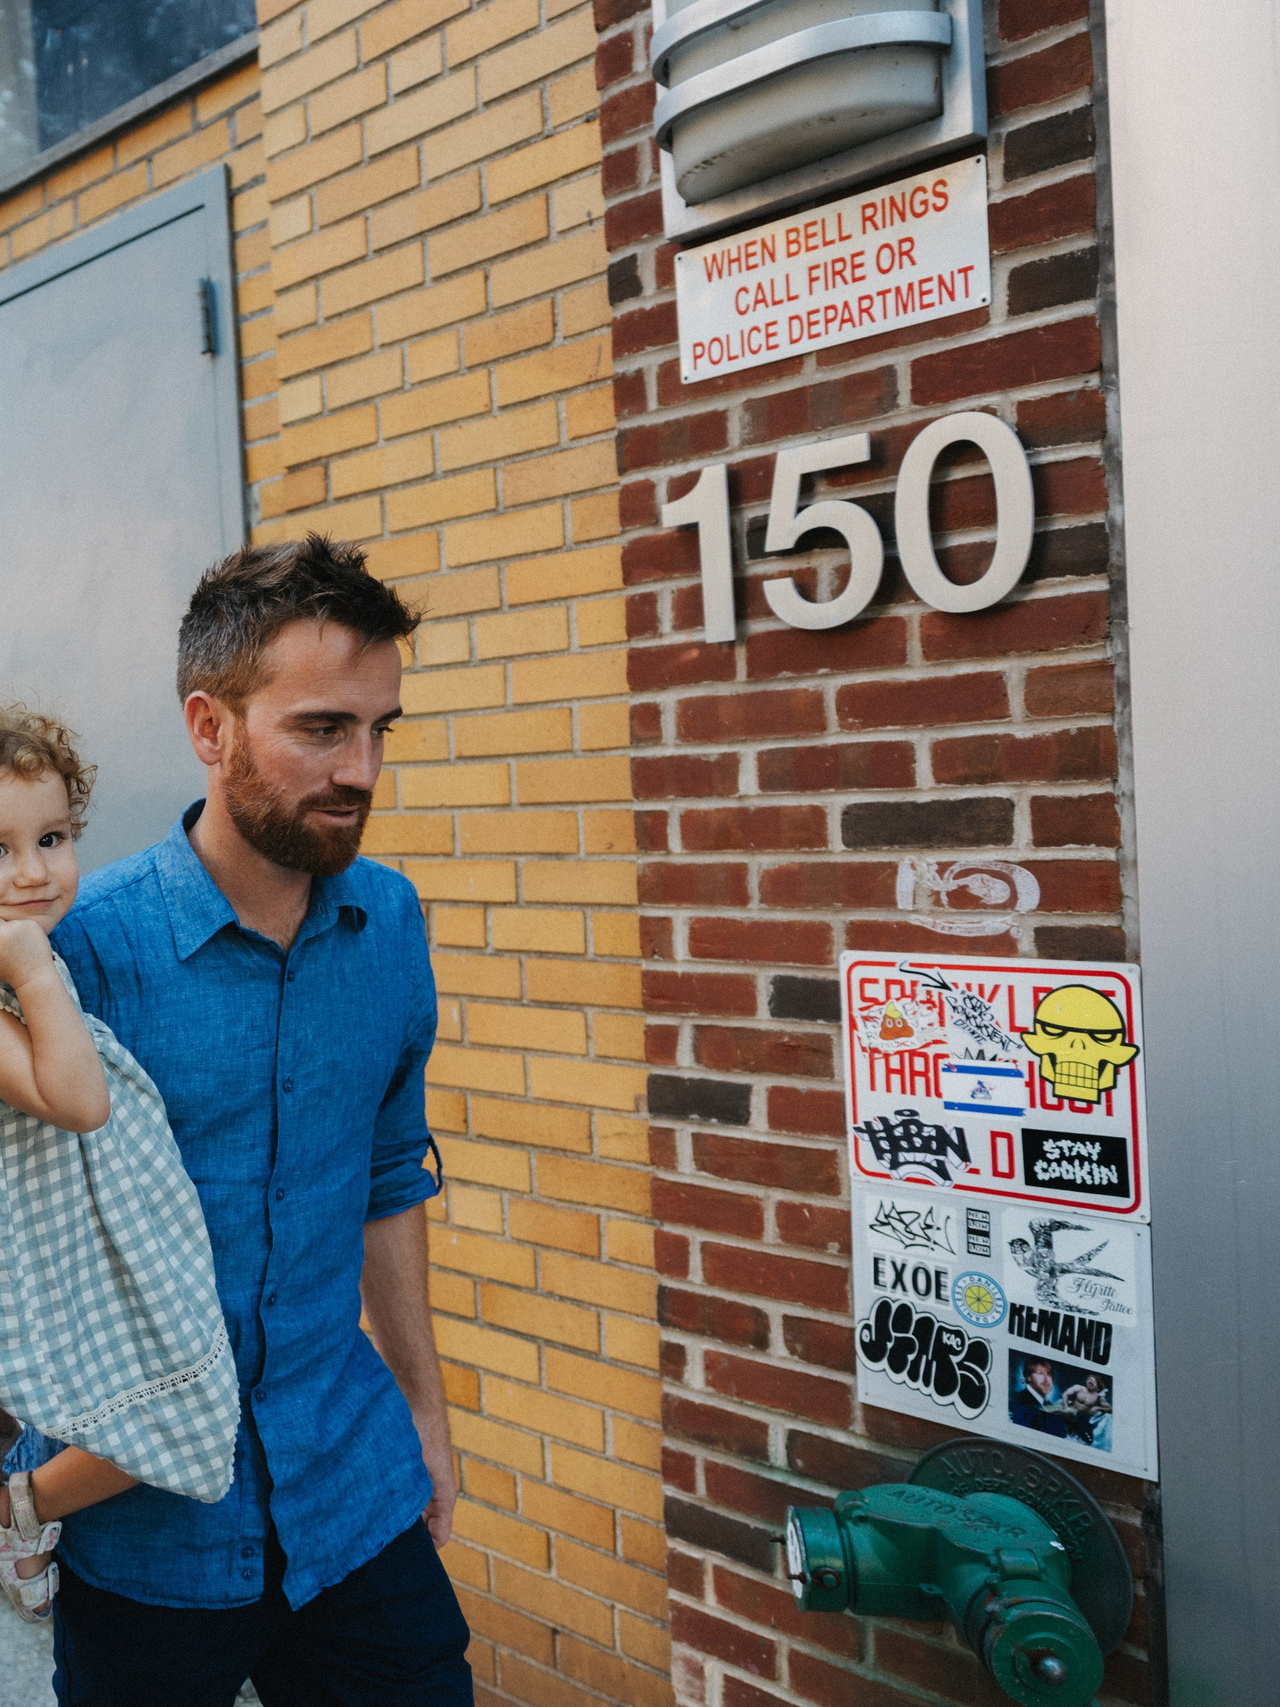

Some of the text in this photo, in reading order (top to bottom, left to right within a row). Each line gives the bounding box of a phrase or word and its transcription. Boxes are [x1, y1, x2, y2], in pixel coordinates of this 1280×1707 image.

[704, 179, 949, 283] WHEN BELL RINGS
[735, 236, 916, 316] CALL FIRE OR
[693, 265, 974, 370] POLICE DEPARTMENT
[661, 411, 1034, 643] 150
[1033, 1159, 1119, 1185] COOKIN
[1042, 1138, 1102, 1161] STAY
[874, 1255, 950, 1303] EXOE
